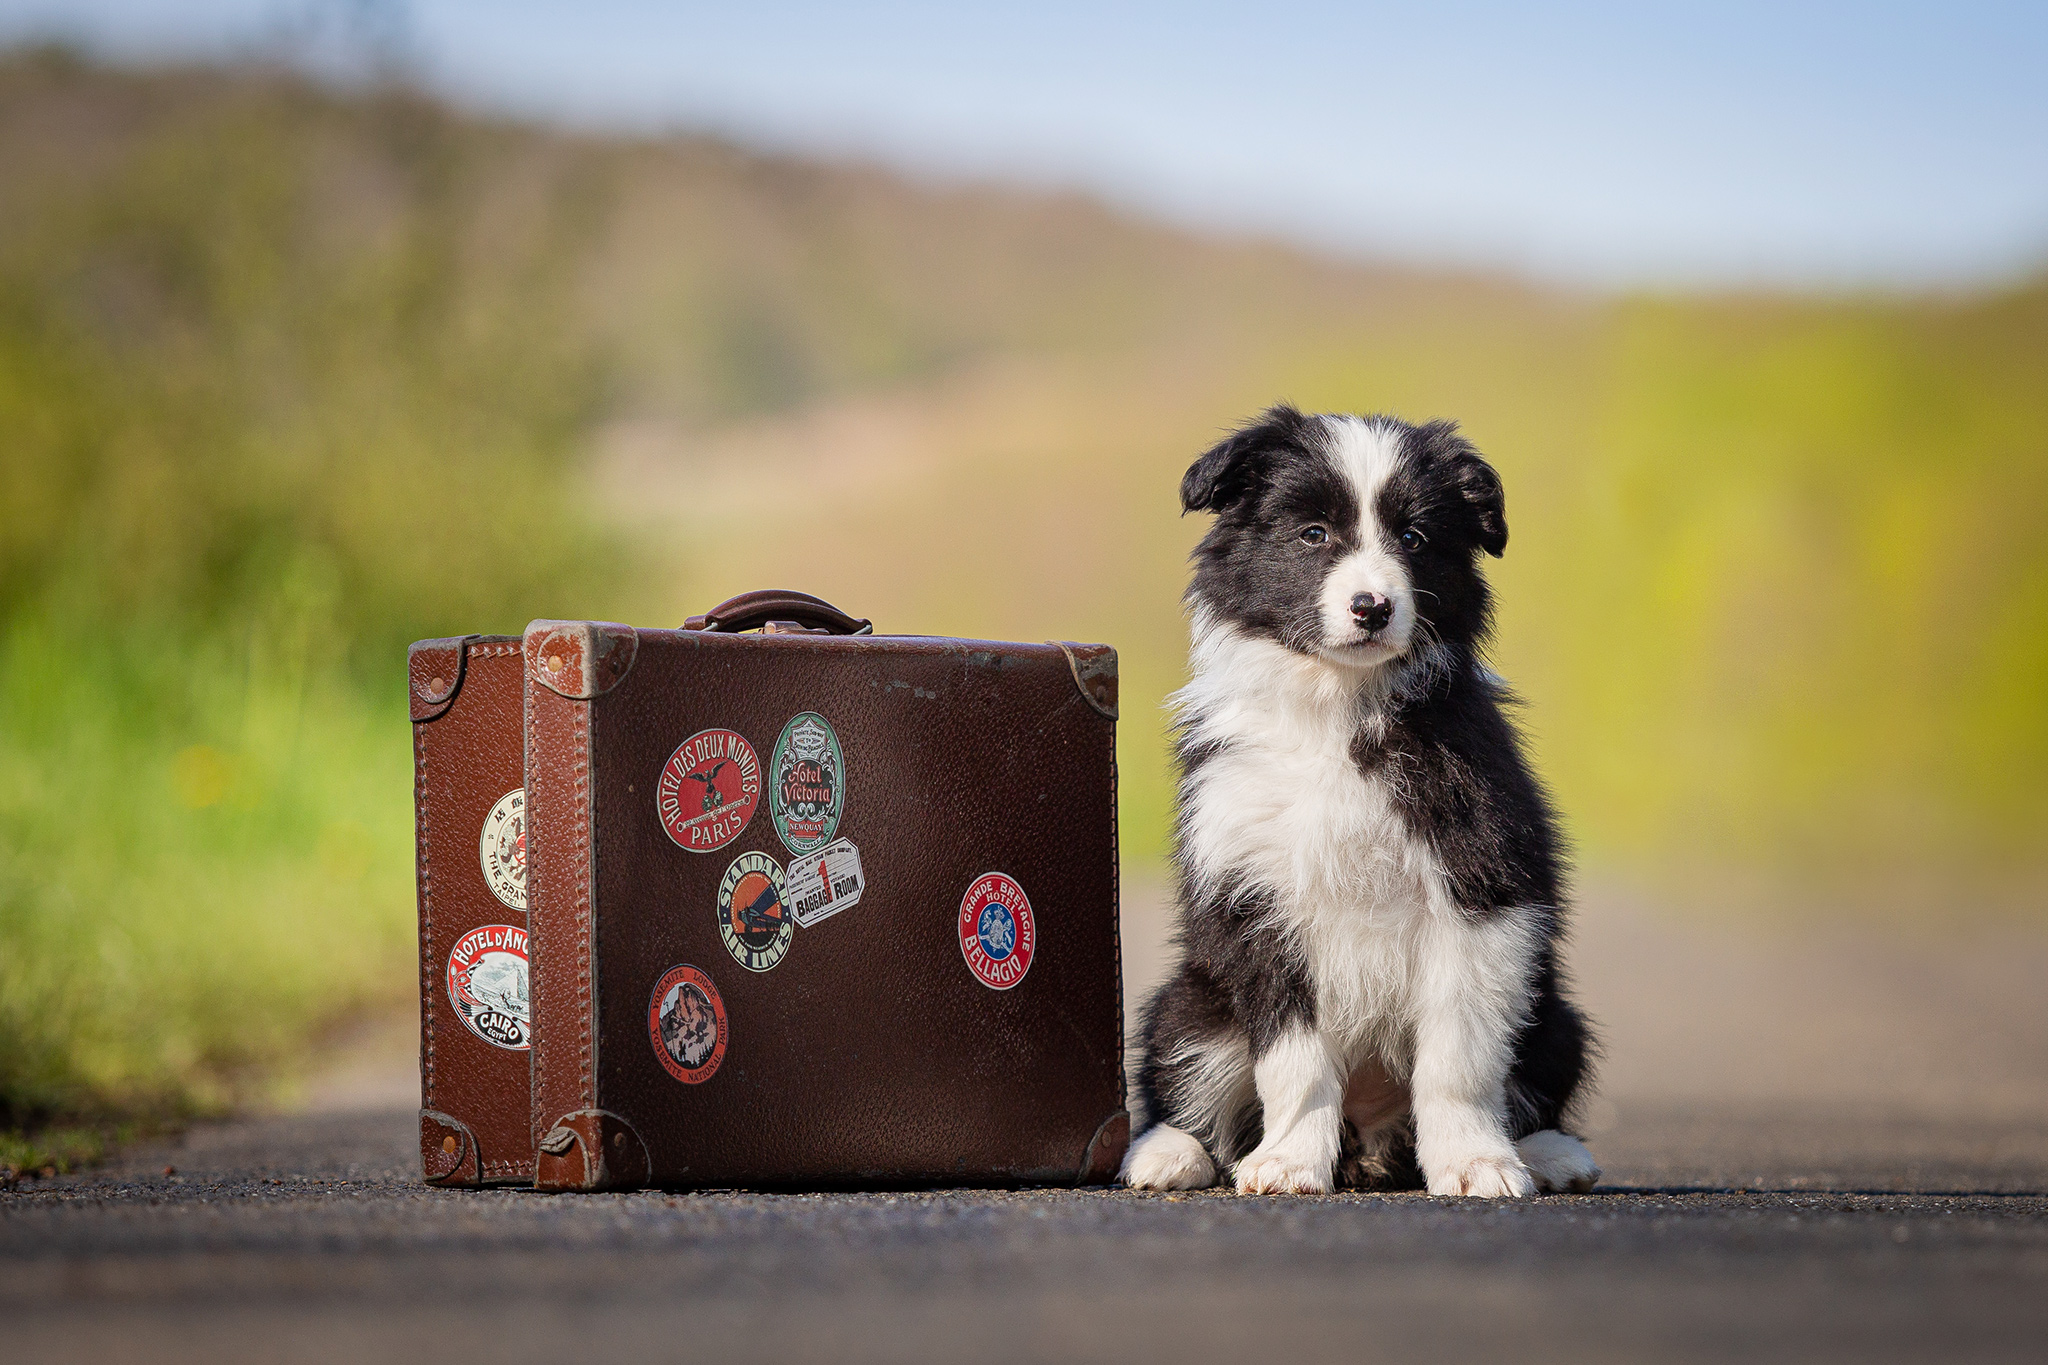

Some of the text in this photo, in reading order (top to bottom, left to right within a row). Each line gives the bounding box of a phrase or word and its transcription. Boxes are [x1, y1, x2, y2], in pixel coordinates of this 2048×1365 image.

[672, 745, 697, 778] DES
[695, 734, 724, 763] DEUX
[727, 735, 758, 793] MONDES
[788, 761, 822, 783] Hotel
[783, 782, 831, 806] Victoria
[691, 811, 742, 845] PARIS
[789, 823, 823, 833] NEWQUAY
[489, 851, 502, 880] THE
[720, 855, 789, 909] STANDARD
[818, 860, 833, 903] 1
[796, 887, 833, 918] BAGGAGE
[833, 874, 859, 900] ROOM
[964, 881, 1031, 952] GRANDE BRETAGNE
[453, 930, 494, 966] HOTEL
[721, 922, 791, 969] AIR LINES
[965, 934, 1022, 982] BELLAGIO
[653, 969, 717, 1010] YOSEMITE LODGE
[479, 1013, 519, 1040] CAIRO
[487, 1028, 507, 1040] EGYPT
[651, 1017, 726, 1082] YOSEMITE NATIONAL PARK
